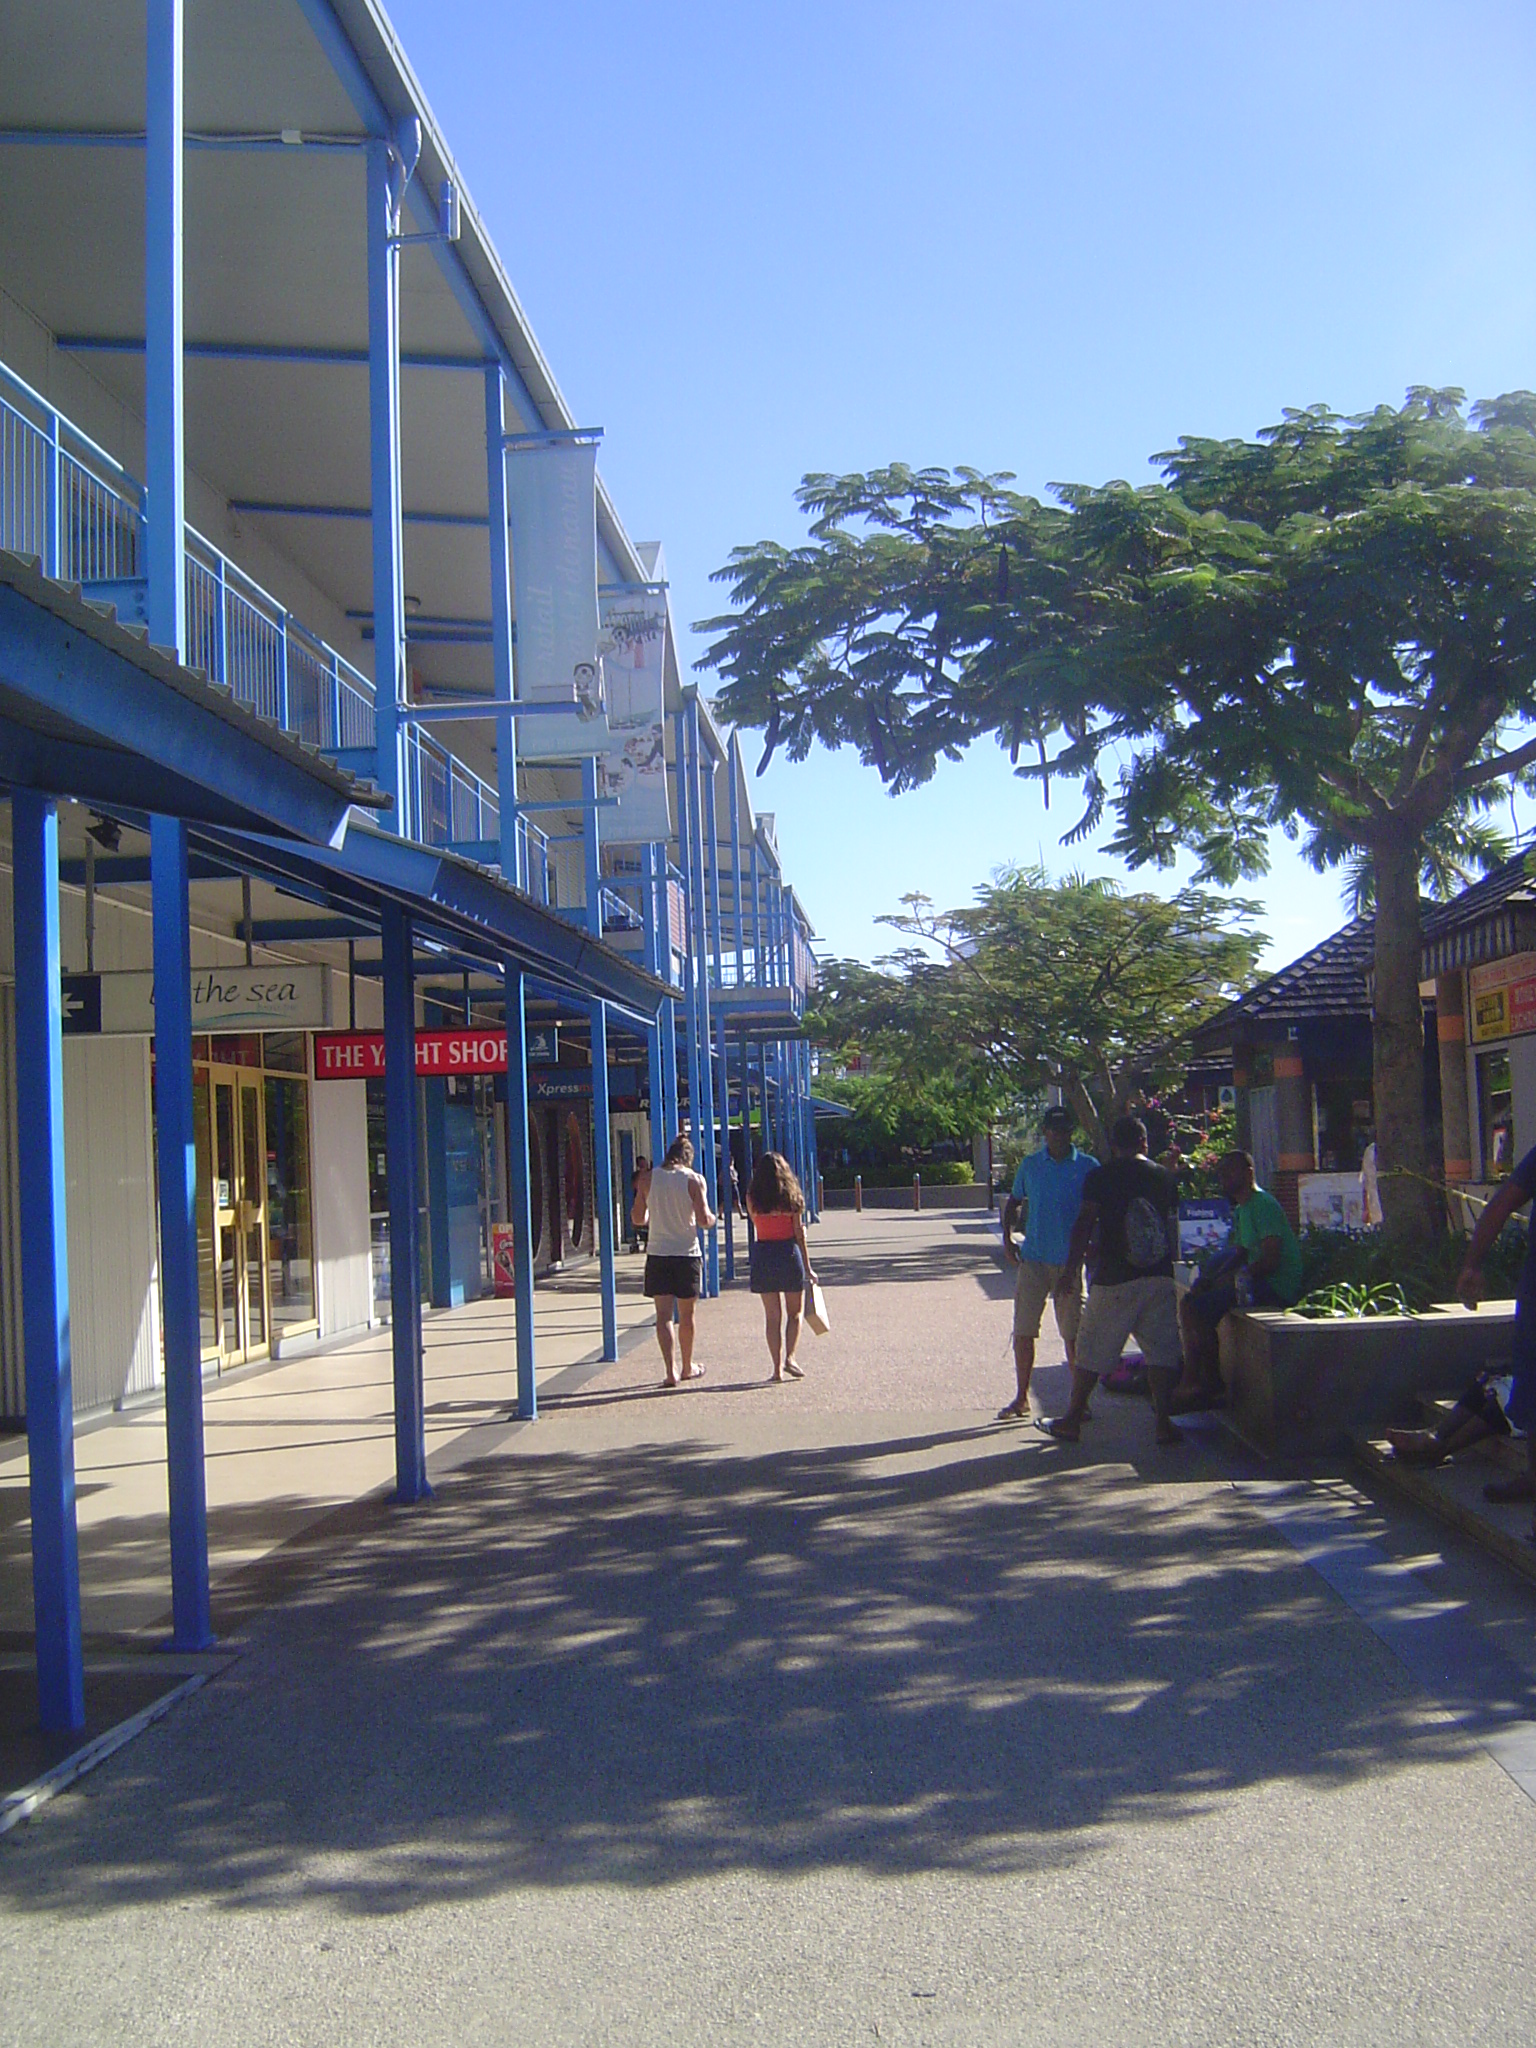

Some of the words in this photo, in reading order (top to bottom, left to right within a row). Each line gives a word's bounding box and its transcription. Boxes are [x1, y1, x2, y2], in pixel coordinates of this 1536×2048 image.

[193, 974, 240, 1004] the
[246, 982, 298, 1003] sea
[321, 1044, 364, 1068] THE
[369, 1040, 443, 1067] YHT
